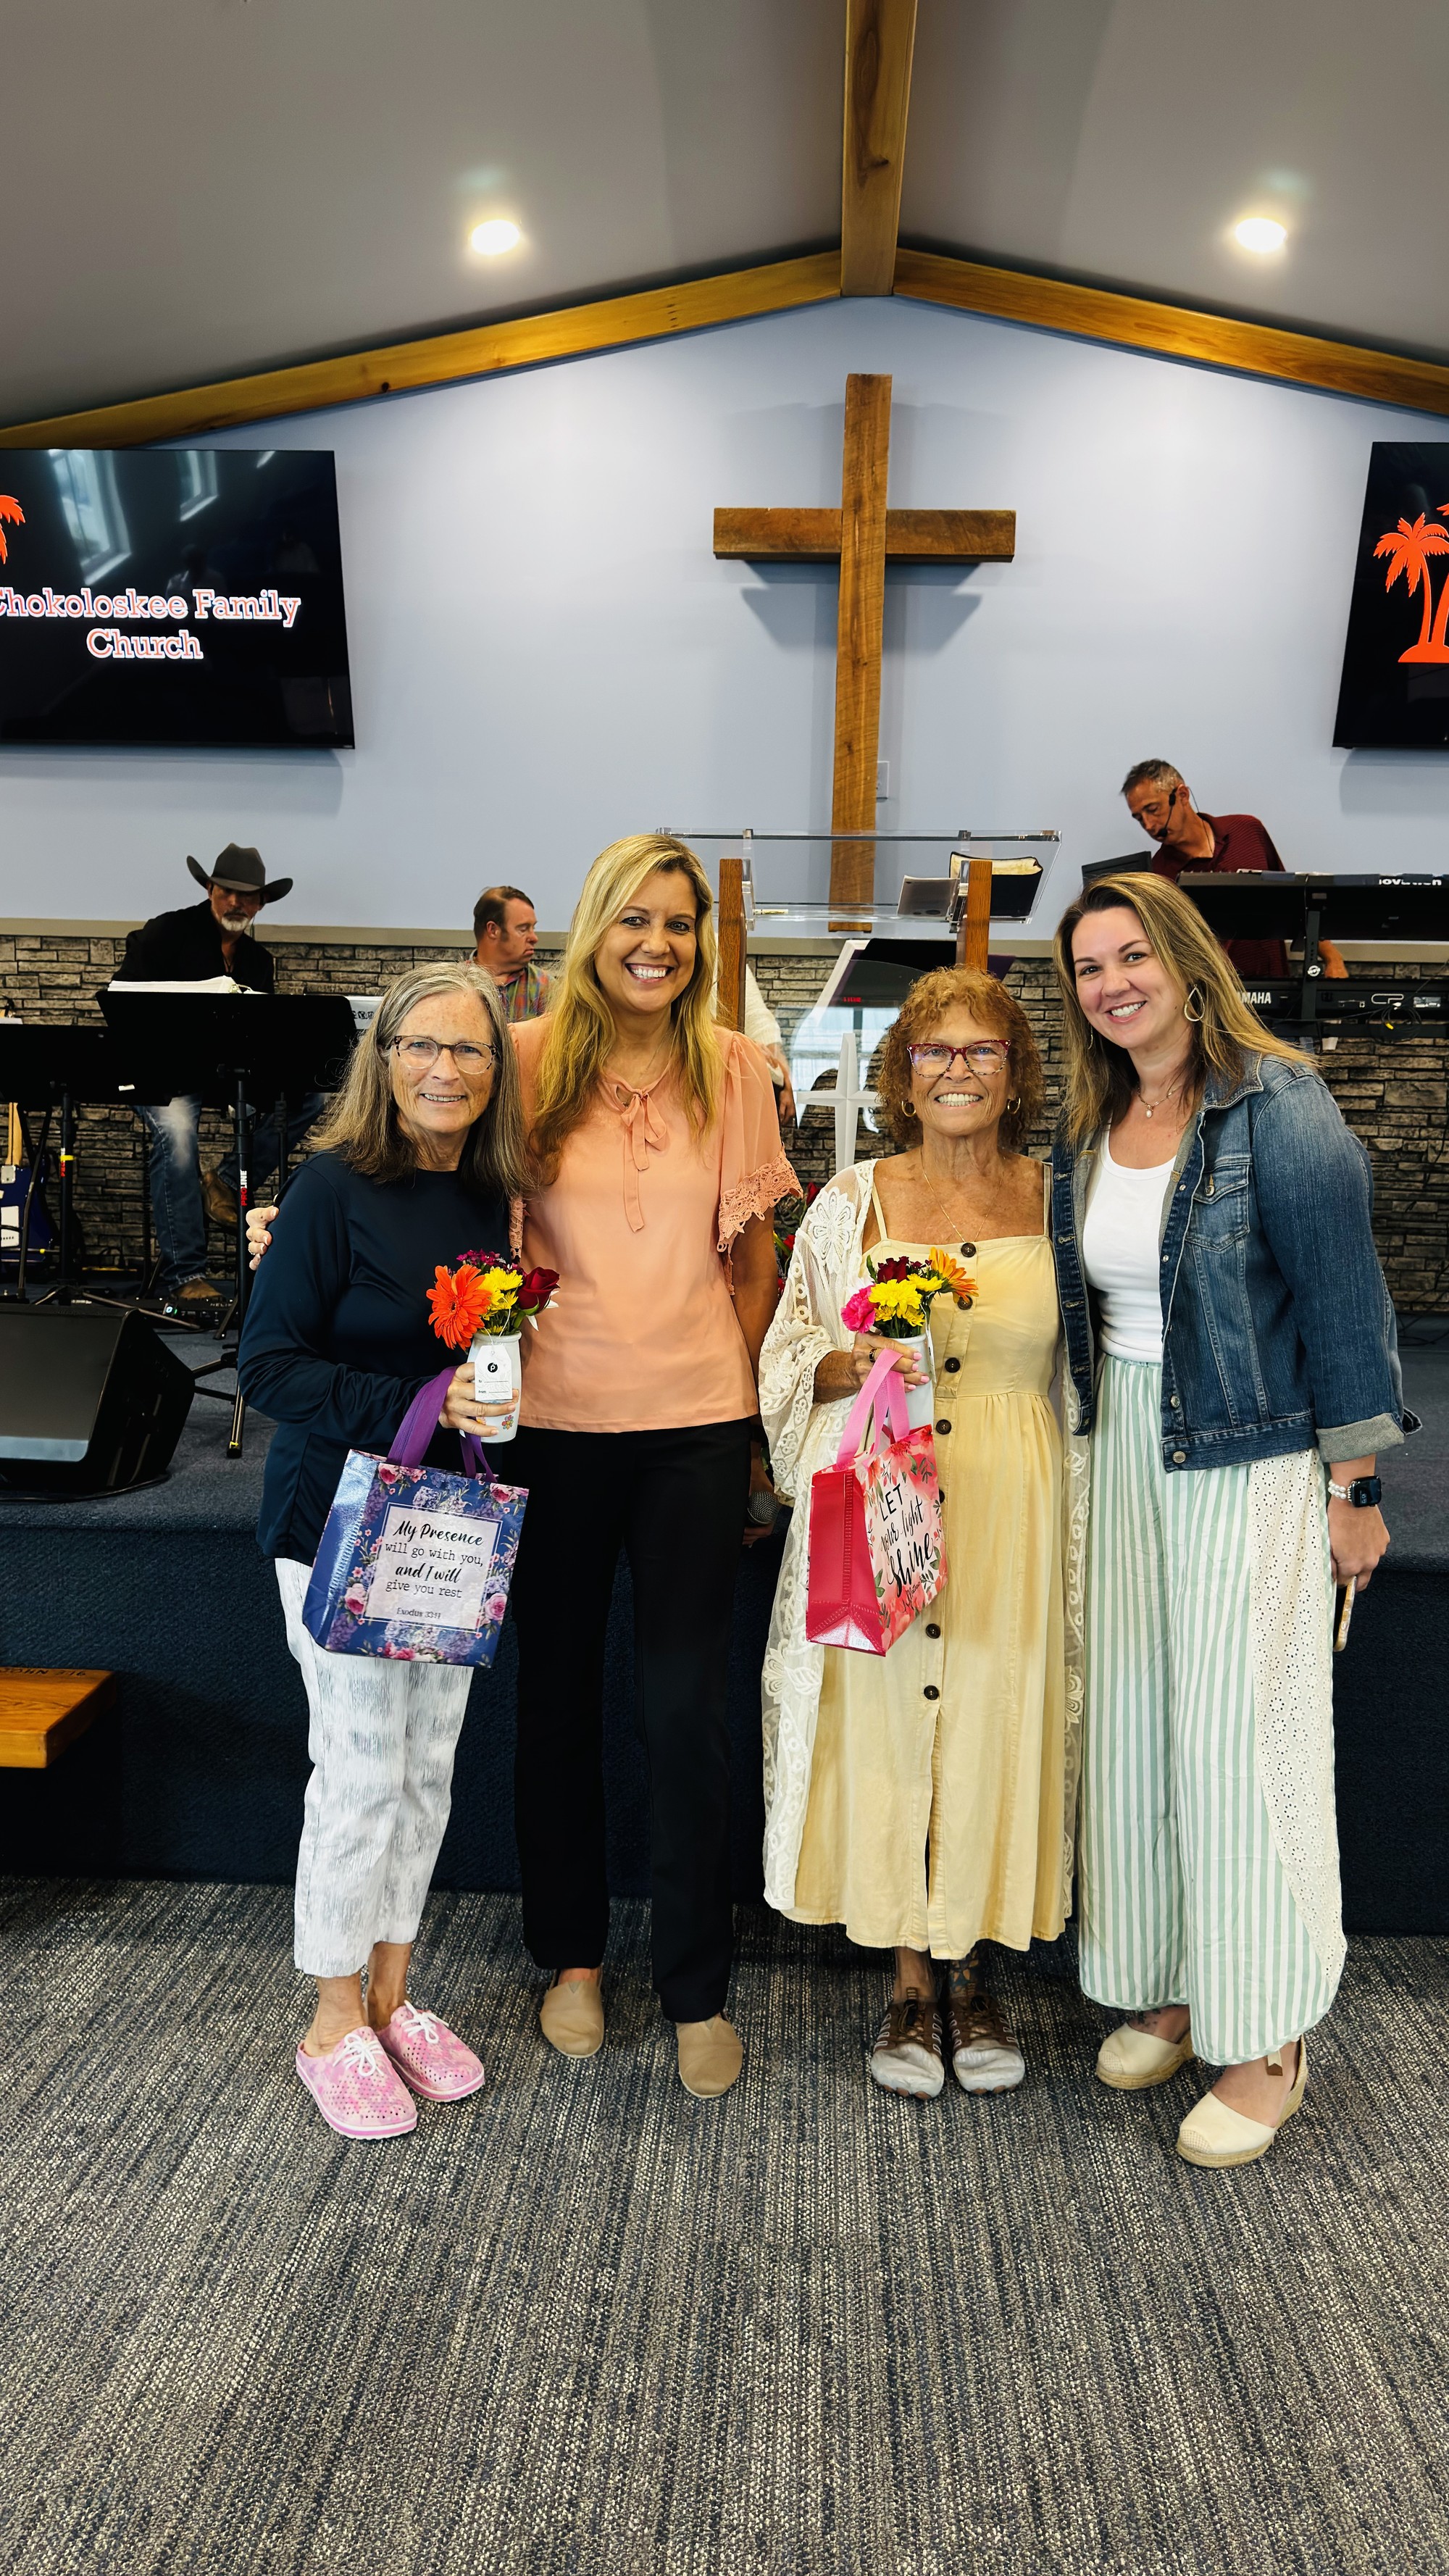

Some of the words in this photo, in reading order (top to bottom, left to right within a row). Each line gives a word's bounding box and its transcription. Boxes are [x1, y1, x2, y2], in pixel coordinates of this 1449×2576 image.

[192, 588, 301, 628] Family
[86, 628, 204, 659] Church
[879, 1483, 903, 1522] LET
[393, 1520, 417, 1543] My
[419, 1523, 484, 1546] Presence
[880, 1522, 899, 1566] your
[900, 1495, 924, 1538] light
[385, 1542, 408, 1554] will
[411, 1547, 425, 1559] go
[429, 1548, 456, 1561] with
[459, 1554, 484, 1567] you,
[395, 1562, 426, 1578] and
[425, 1566, 435, 1581] I
[434, 1567, 462, 1583] will
[385, 1579, 410, 1593] give
[413, 1584, 435, 1595] you
[438, 1587, 463, 1598] rest
[396, 1607, 423, 1617] Exodus
